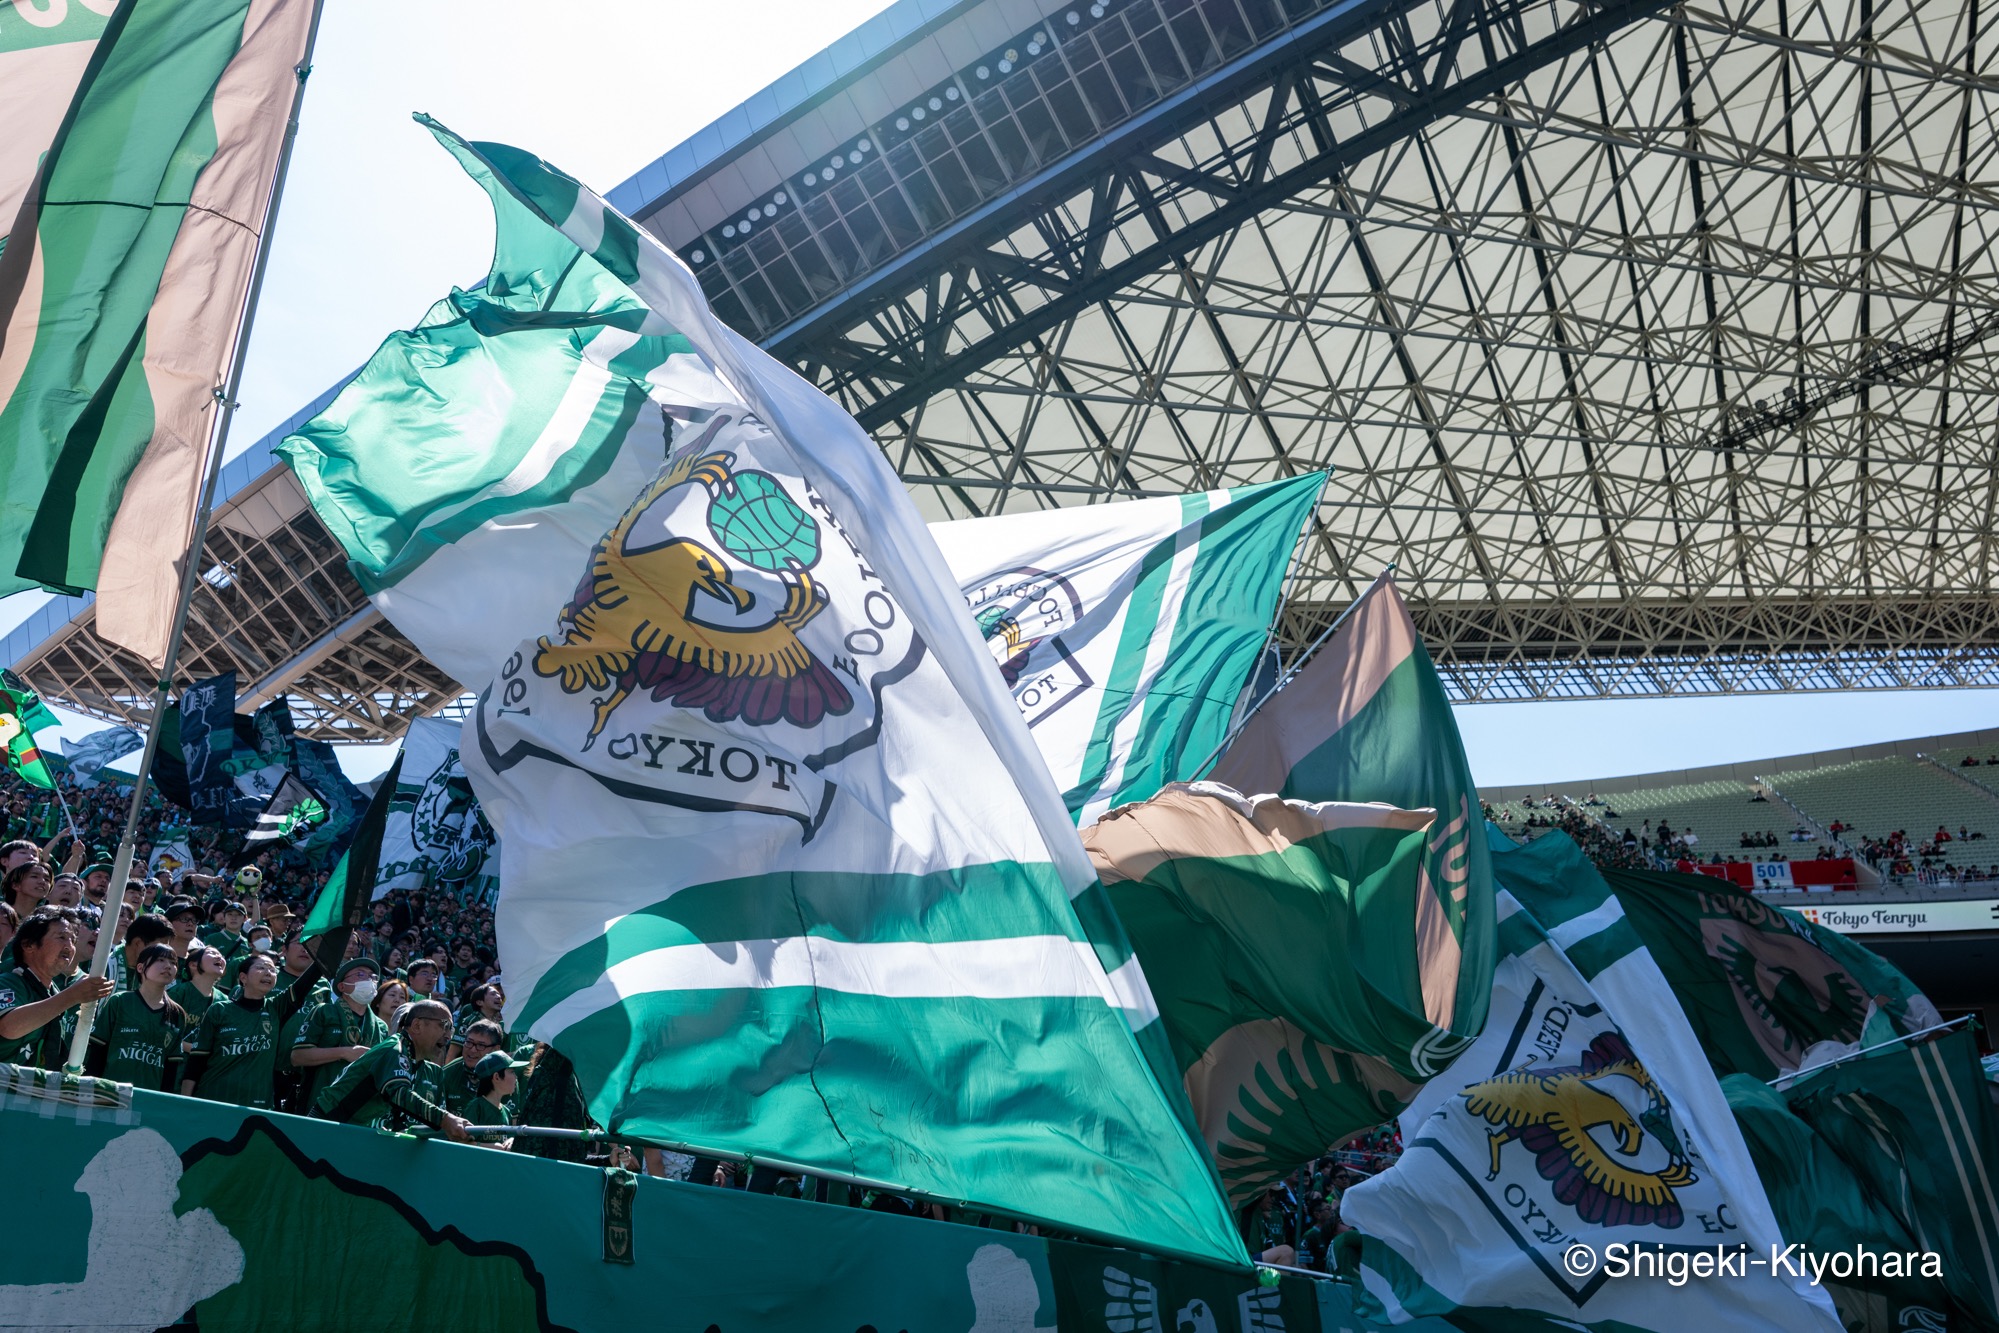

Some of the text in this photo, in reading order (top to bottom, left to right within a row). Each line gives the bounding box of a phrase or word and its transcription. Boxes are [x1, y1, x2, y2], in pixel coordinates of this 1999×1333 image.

[1757, 863, 1785, 878] 501
[1822, 909, 1928, 929] Tokyo Tenryu
[118, 1047, 164, 1069] NICIGA
